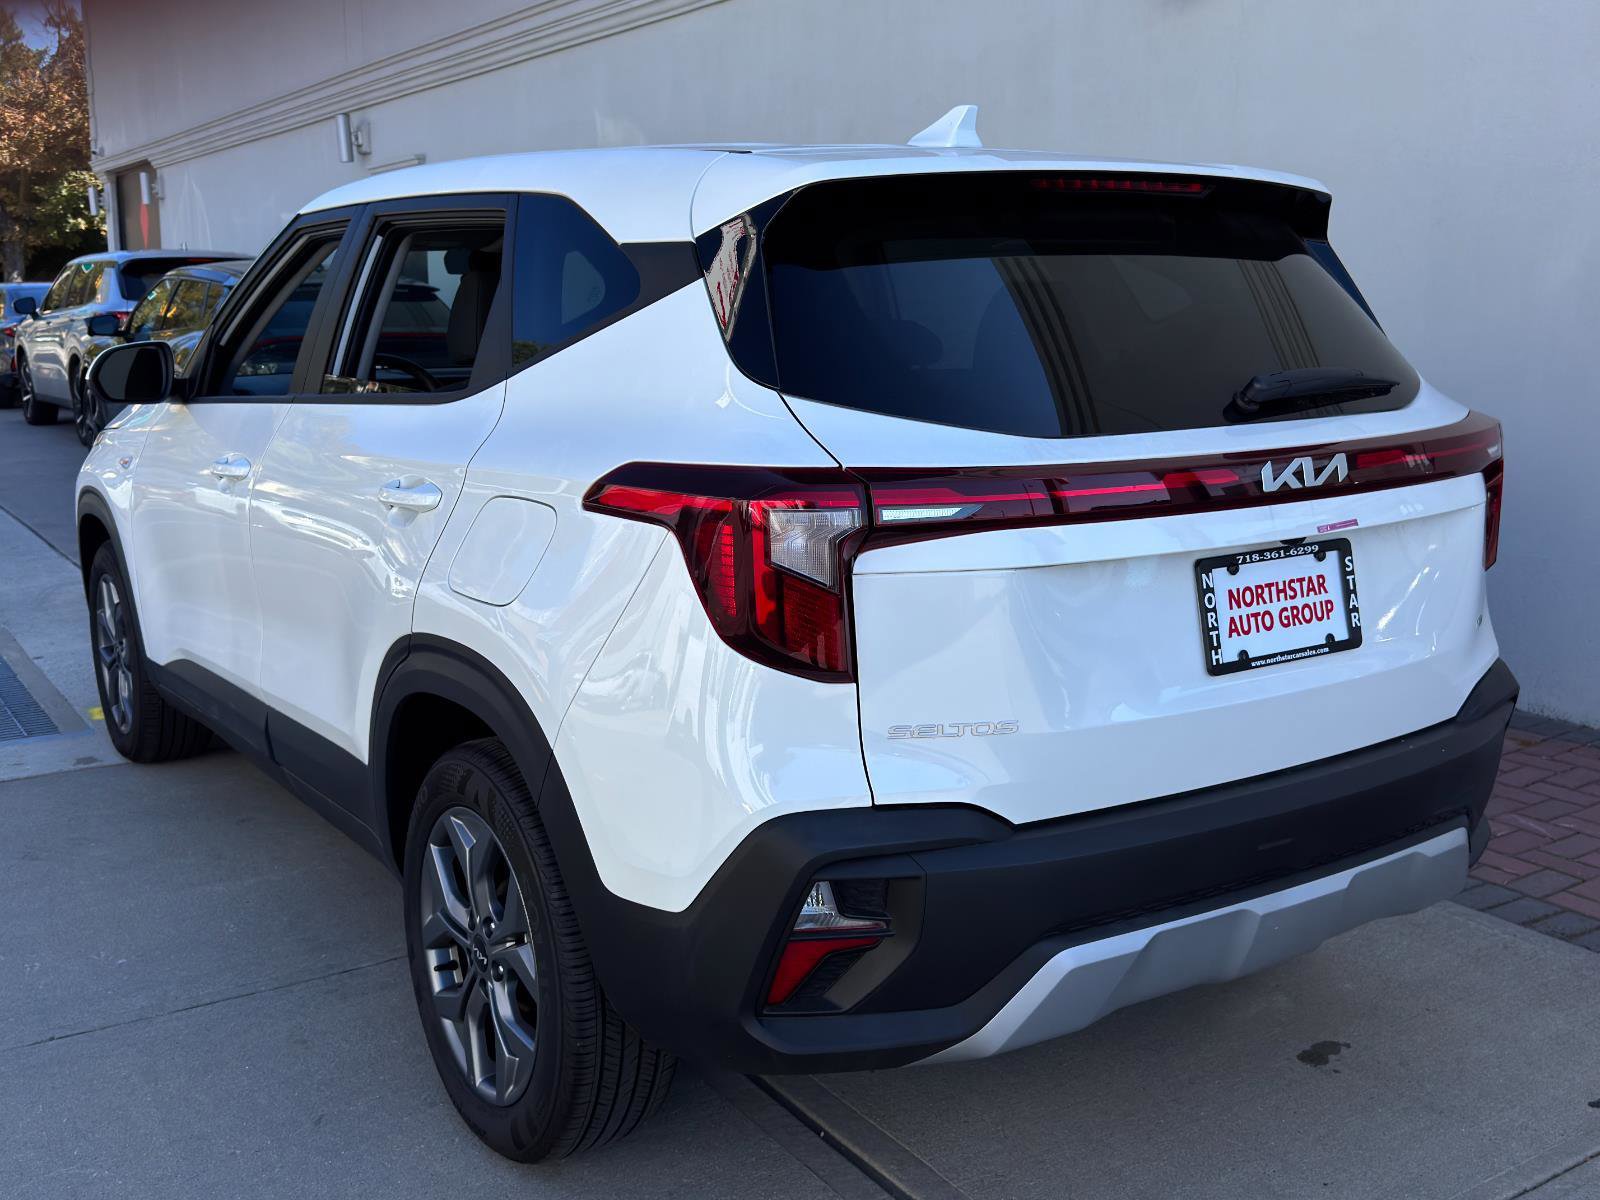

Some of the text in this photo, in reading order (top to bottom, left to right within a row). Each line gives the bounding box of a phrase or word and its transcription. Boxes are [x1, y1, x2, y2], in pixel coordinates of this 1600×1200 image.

[1261, 452, 1348, 492] KIA
[1236, 544, 1319, 564] 718-361-6299
[1227, 574, 1328, 610] NORTHSTAR
[1344, 556, 1361, 628] STAR
[1201, 573, 1223, 665] NORTH
[1228, 599, 1334, 638] AUTO GROUP
[1251, 647, 1329, 667] www.northstarcarsales.com
[887, 720, 1019, 739] SELTOS
